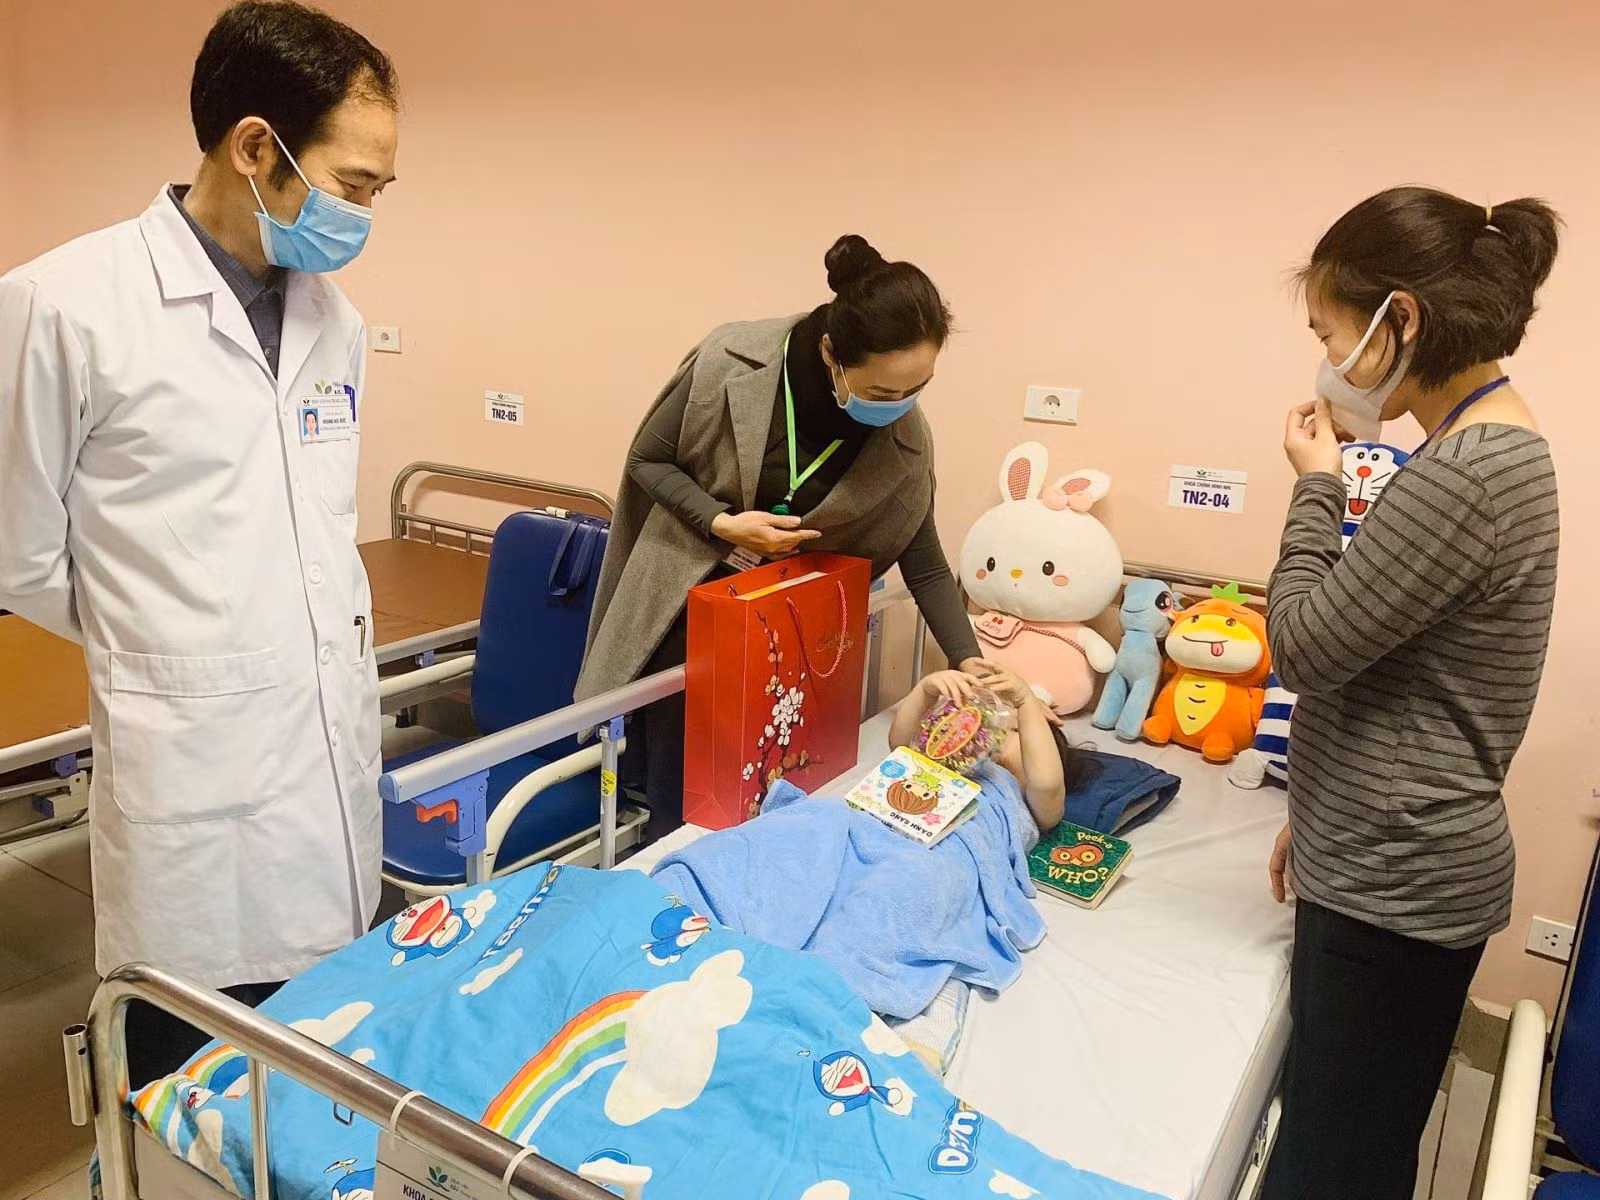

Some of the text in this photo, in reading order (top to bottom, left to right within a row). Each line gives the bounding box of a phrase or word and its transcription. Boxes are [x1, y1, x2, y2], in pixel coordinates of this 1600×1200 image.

[491, 407, 517, 422] TN2-05
[1182, 489, 1230, 508] TN2-04
[1048, 865, 1109, 885] WHO?
